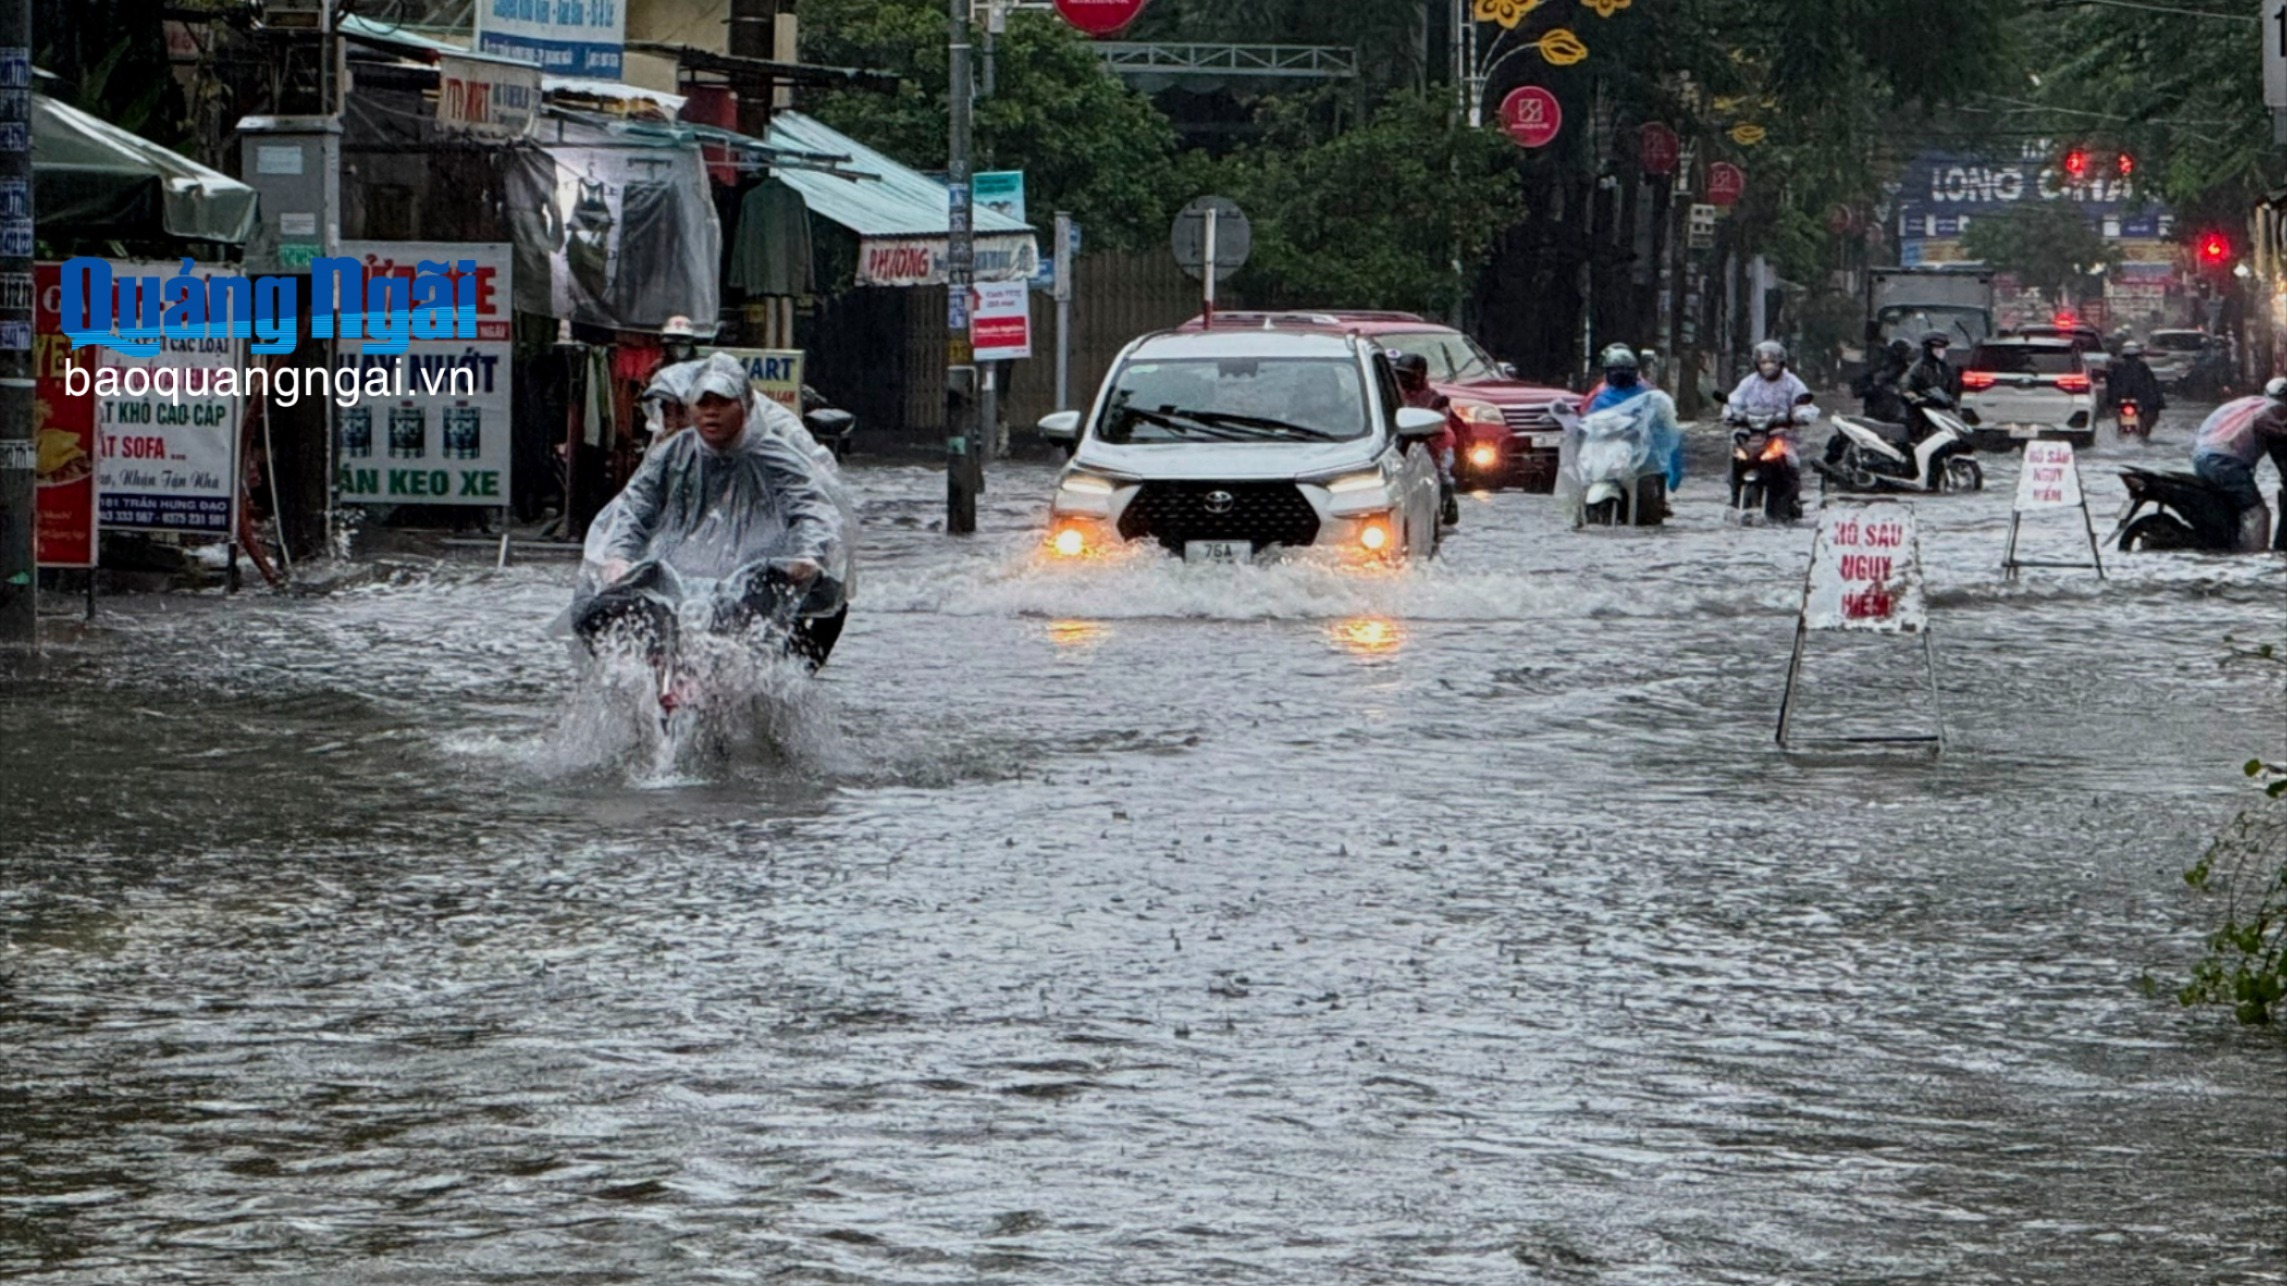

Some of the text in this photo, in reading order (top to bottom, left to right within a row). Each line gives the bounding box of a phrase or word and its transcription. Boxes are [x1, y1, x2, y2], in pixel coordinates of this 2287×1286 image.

[1932, 167, 2023, 202] LONG
[409, 347, 498, 393] NHỚT
[119, 396, 150, 424] KHÔ
[157, 402, 189, 425] CAO
[193, 396, 226, 427] CẤP
[122, 436, 165, 460] SOFA
[388, 469, 449, 496] KEO
[459, 471, 499, 496] XE
[1204, 543, 1232, 558] 76A
[1840, 554, 1892, 581] NGUY
